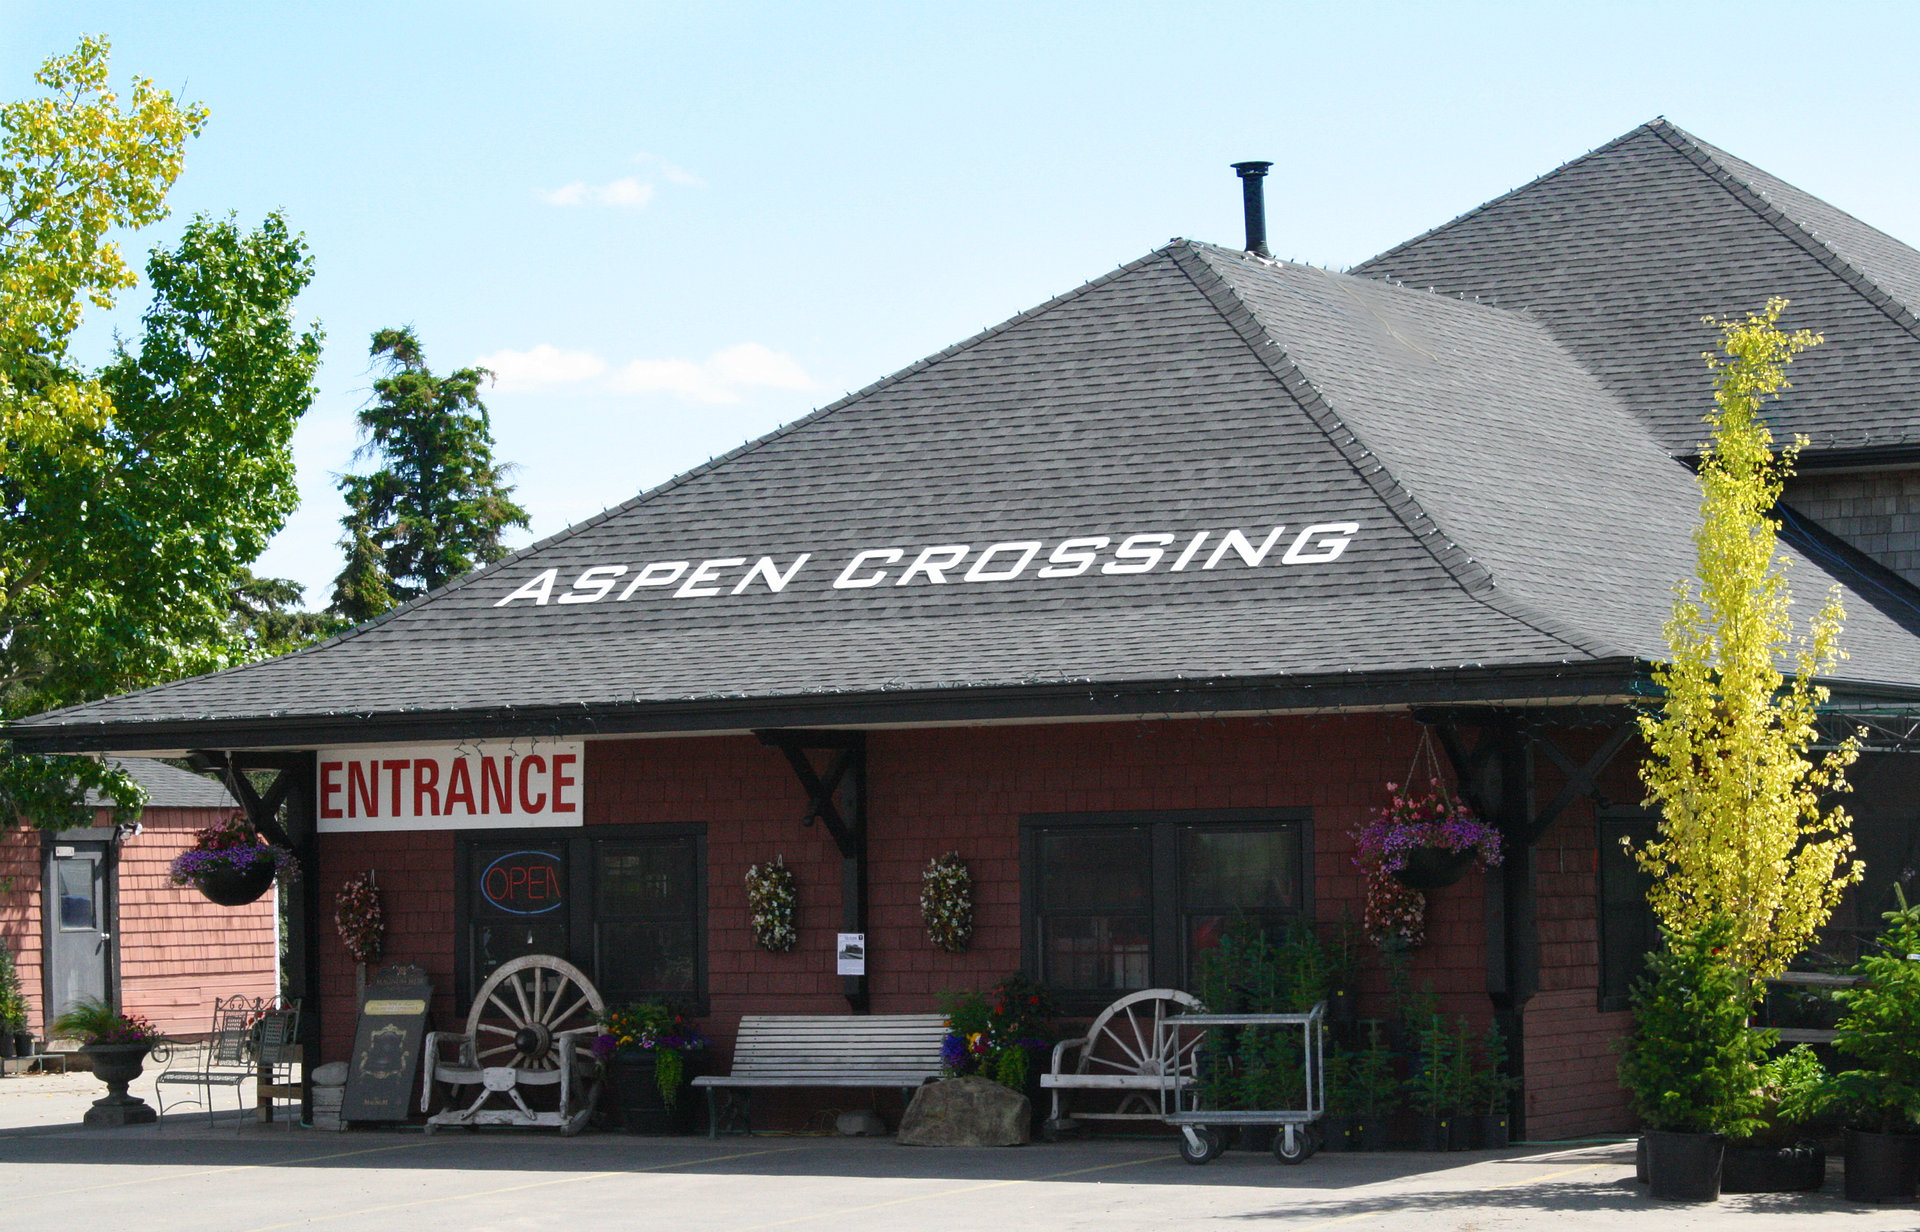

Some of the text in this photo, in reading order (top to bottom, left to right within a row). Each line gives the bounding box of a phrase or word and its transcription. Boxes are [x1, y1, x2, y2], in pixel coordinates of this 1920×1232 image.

[493, 522, 1360, 608] ASPEN CROSSING
[319, 753, 577, 819] ENTRANCE
[486, 865, 562, 900] OPEN
